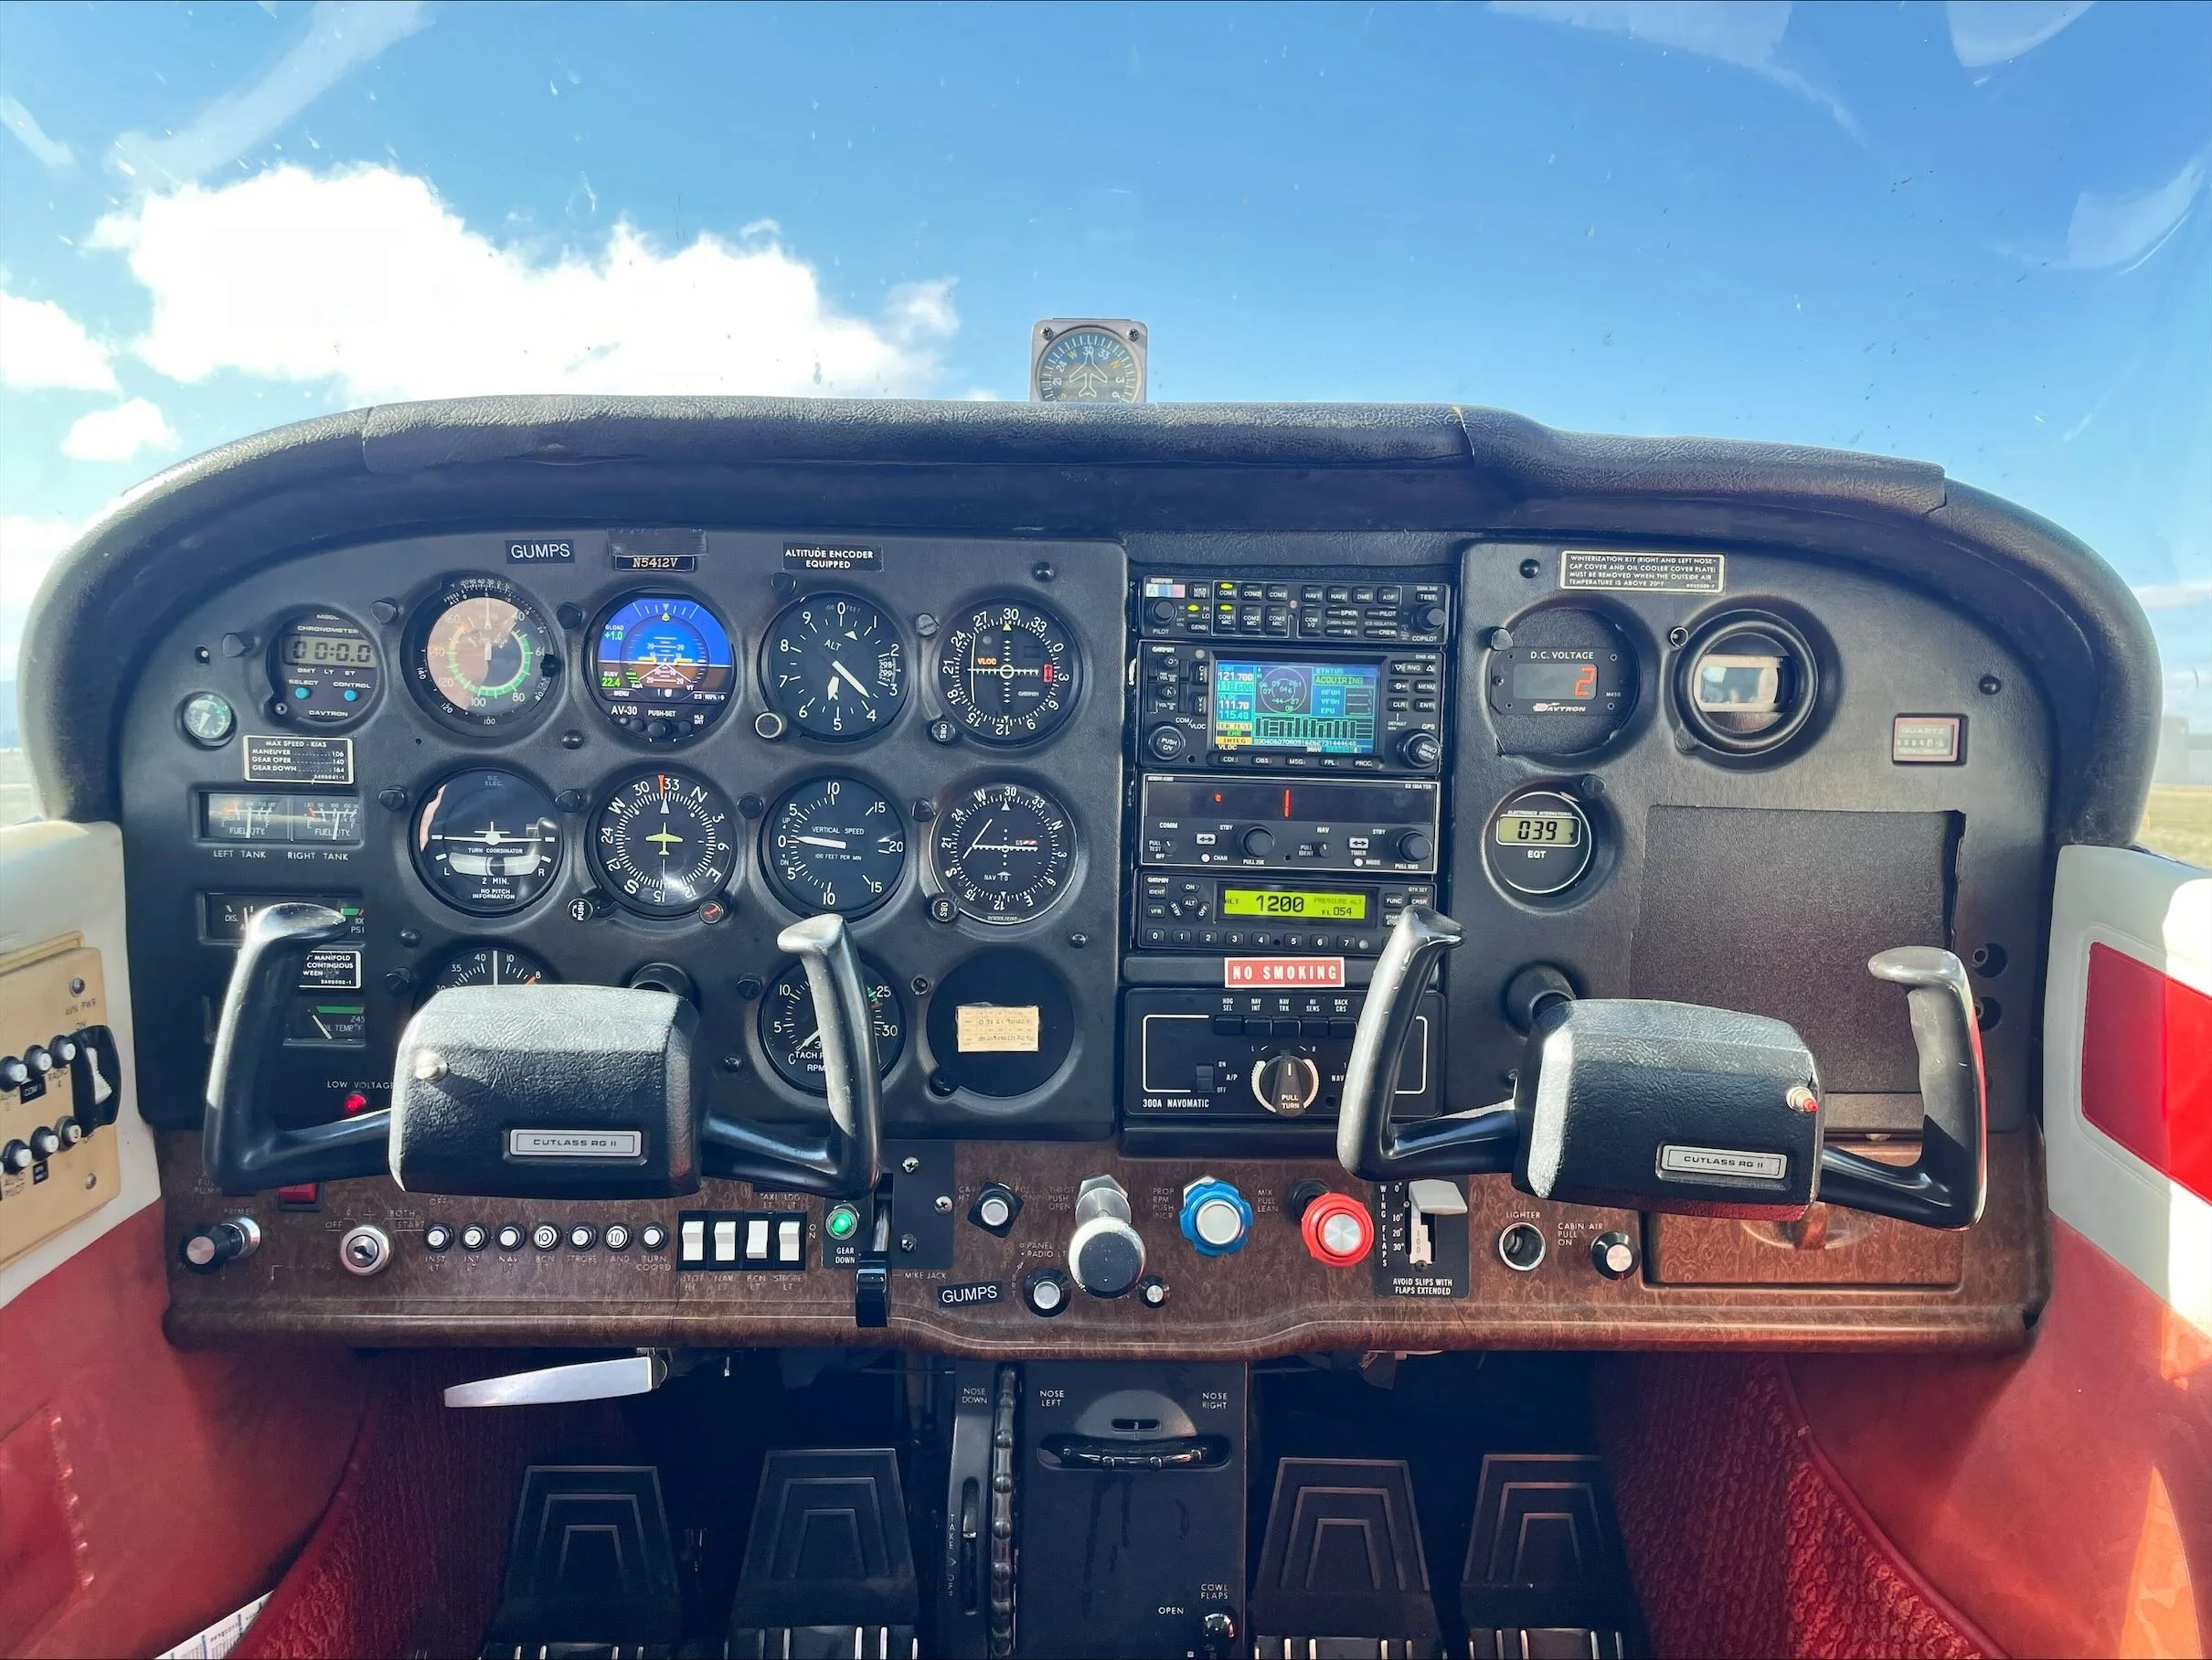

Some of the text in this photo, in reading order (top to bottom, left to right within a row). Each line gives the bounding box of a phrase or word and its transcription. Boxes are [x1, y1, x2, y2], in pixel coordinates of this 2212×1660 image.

[1098, 348, 1111, 360] 33
[1056, 360, 1067, 372] 24
[511, 544, 570, 559] GUMPS
[785, 548, 874, 559] ALTITUDE ENCODER
[633, 557, 678, 568] N5412V
[805, 559, 851, 569] EQUIPPED
[1570, 555, 1623, 563] WINTERIZATION
[836, 601, 846, 615] 0
[973, 611, 988, 628] 27
[1004, 608, 1019, 621] 30
[297, 624, 358, 633] CHRONOMETER
[1030, 616, 1048, 633] 33
[604, 631, 623, 641] +1.0
[780, 639, 789, 653] 8
[824, 640, 842, 652] ALT
[1530, 651, 1594, 660] D.C. VOLTAGE
[977, 657, 996, 665] VLOC
[601, 677, 621, 687] 22.4
[1573, 665, 1596, 696] 2
[512, 692, 525, 702] 80
[471, 697, 486, 708] 100
[309, 709, 348, 718] DAVTRON
[611, 706, 638, 716] AV-30
[647, 709, 675, 718] PUSH-SET
[834, 718, 842, 731] 5
[632, 781, 650, 797] 30
[664, 778, 680, 791] 33
[827, 782, 840, 795] 10
[1005, 786, 1017, 797] 30
[874, 802, 886, 814] 15
[812, 826, 864, 835] VERTICAL SPEED
[1517, 820, 1558, 841] 039
[888, 841, 904, 853] 20
[213, 850, 267, 859] LEFT TANK
[287, 851, 349, 861] RIGHT TANK
[1527, 850, 1547, 859] EGT
[1255, 894, 1305, 913] 1200
[1333, 906, 1352, 917] 054
[350, 926, 366, 934] PSI
[1291, 937, 1297, 945] 5
[1344, 939, 1350, 947] 7
[474, 953, 486, 963] 40
[505, 953, 515, 963] 10
[1231, 965, 1337, 981] NO SMOKING
[876, 985, 892, 998] 25
[881, 1025, 899, 1038] 30
[794, 1051, 818, 1060] TACH
[327, 1080, 348, 1089] LOW
[1143, 1098, 1209, 1108] 300A NAVOMATIC
[533, 1138, 617, 1147] CUTLASS RG II
[1684, 1155, 1735, 1167] CUTLASS
[1739, 1160, 1754, 1168] RG
[388, 1209, 415, 1218] BOTH
[1258, 1205, 1279, 1213] LEAN
[1506, 1211, 1541, 1219] LIGHTER
[398, 1220, 425, 1229] START
[1379, 1185, 1388, 1268] WING FLAPS
[1558, 1222, 1603, 1231] CABIN AIR
[1558, 1230, 1578, 1239] PULL
[1558, 1239, 1572, 1247] ON
[836, 1247, 855, 1255] GEAR
[835, 1256, 856, 1264] DOWN
[904, 1272, 947, 1280] MIKE JACK
[1392, 1278, 1453, 1287] AVOID SLIPS WITH
[941, 1285, 998, 1304] GUMPS
[1395, 1286, 1452, 1295] FLAPS EXTENDED
[962, 1388, 986, 1396] NOSE
[1039, 1389, 1065, 1399] NOSE
[1202, 1392, 1228, 1401] NOSE
[962, 1396, 988, 1405] DOWN
[1041, 1399, 1061, 1408] LEFT
[1202, 1400, 1228, 1410] RIGHT
[1200, 1583, 1228, 1592] COWL
[1200, 1591, 1228, 1601] FLAPS
[1158, 1606, 1184, 1615] OPEN
